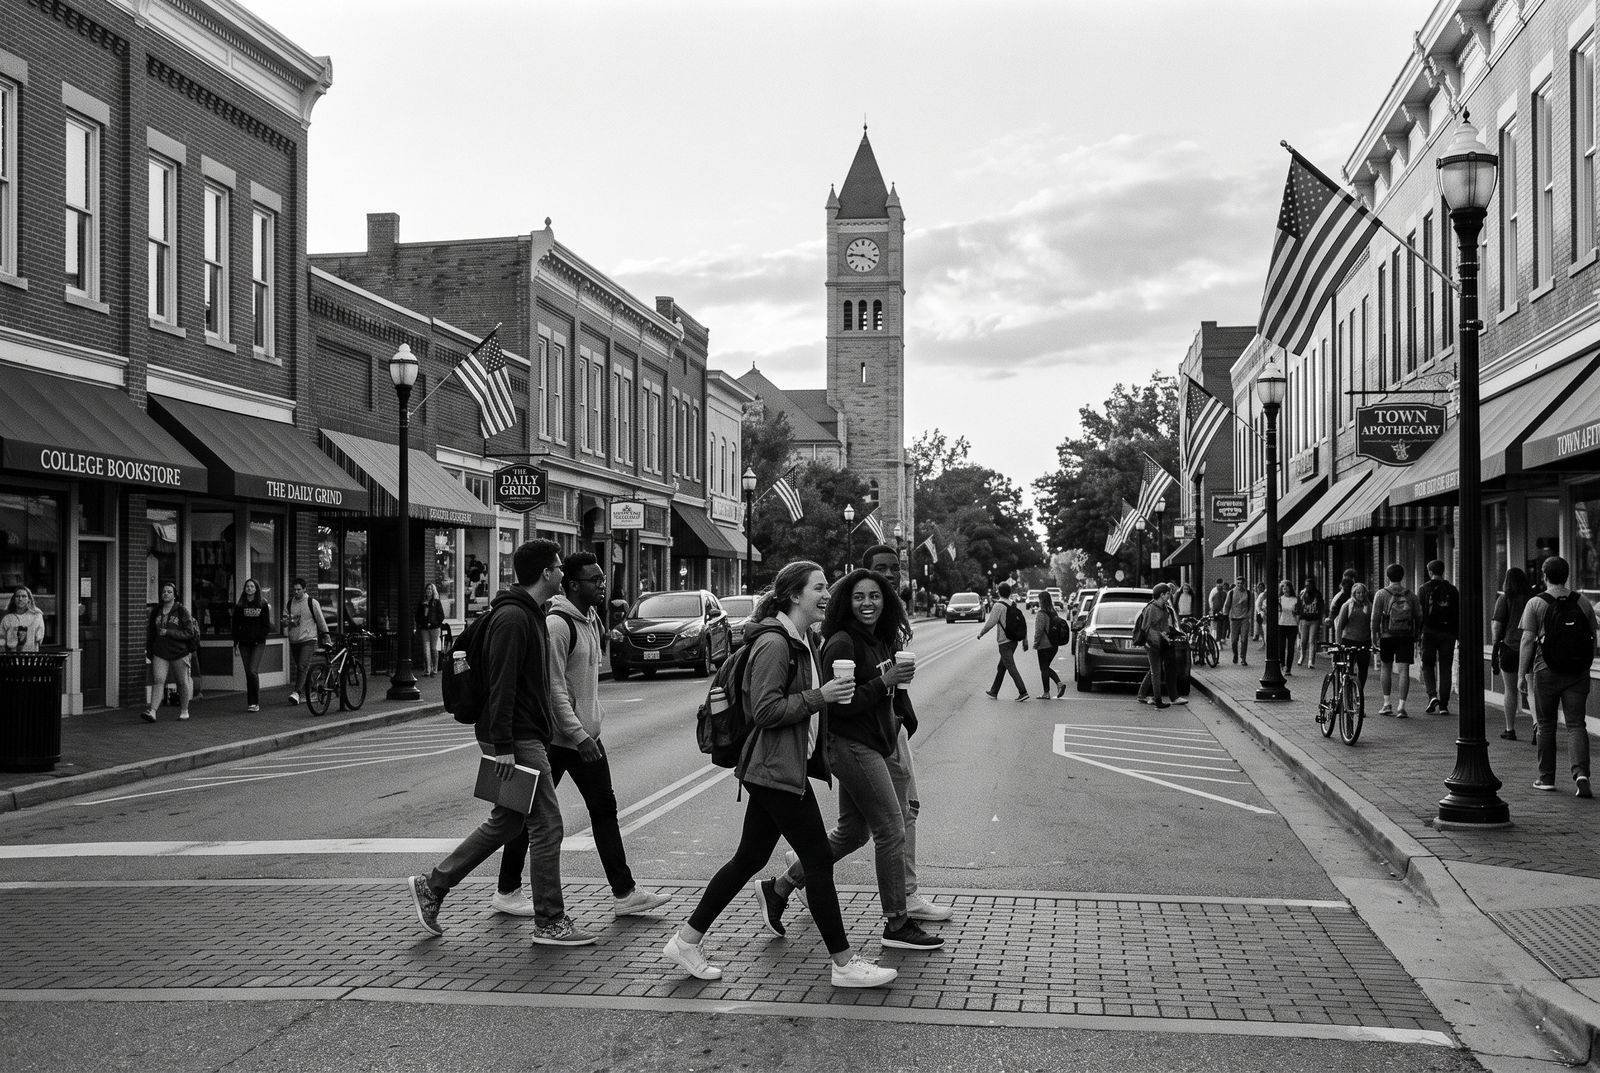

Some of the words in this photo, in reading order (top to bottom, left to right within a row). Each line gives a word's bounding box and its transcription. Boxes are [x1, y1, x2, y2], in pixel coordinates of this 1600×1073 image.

[1374, 409, 1428, 423] TOWN
[1361, 425, 1440, 435] APOTHECARY
[1557, 430, 1580, 456] TOWN
[41, 449, 104, 475] COLLEGE
[107, 458, 181, 486] BOOKSTORE
[502, 475, 539, 485] DAILY
[266, 480, 286, 498] THE
[287, 483, 313, 501] DAILY
[315, 488, 342, 505] GRIND
[500, 485, 541, 496] GRIND
